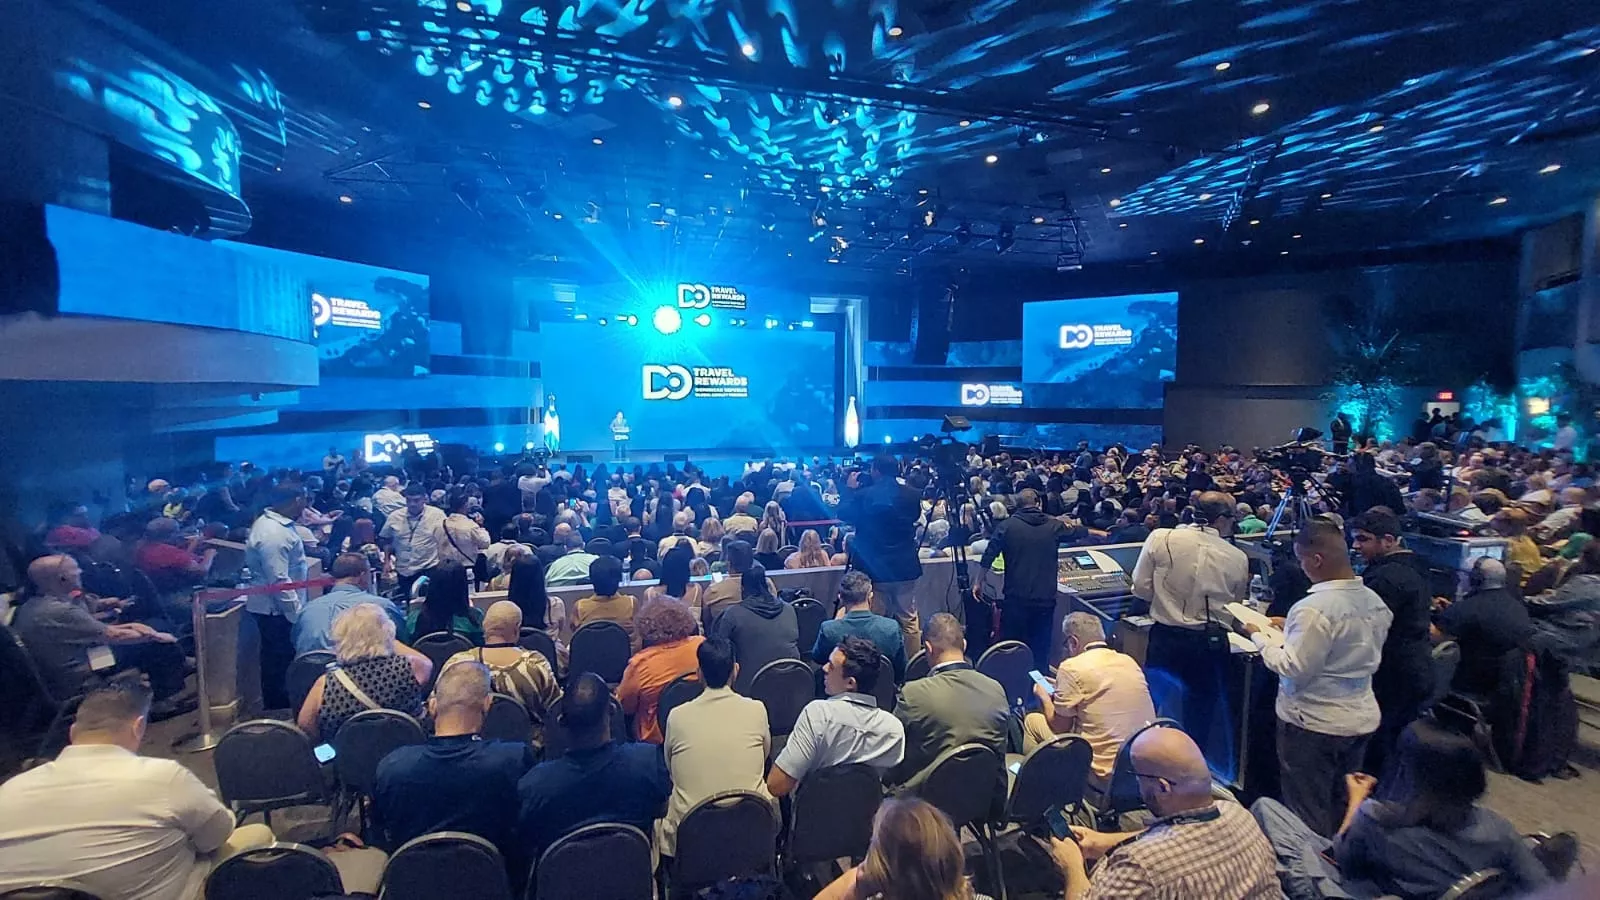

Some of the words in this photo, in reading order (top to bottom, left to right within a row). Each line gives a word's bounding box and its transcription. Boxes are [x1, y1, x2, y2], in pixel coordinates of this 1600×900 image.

[711, 286, 738, 294] TRAVEL
[711, 293, 746, 302] REWARDS
[330, 297, 369, 310] TRAVEL
[332, 306, 381, 319] REWARDS
[1093, 324, 1123, 332] TRAVEL
[693, 367, 735, 377] TRAVEL
[694, 377, 748, 386] REWARDS
